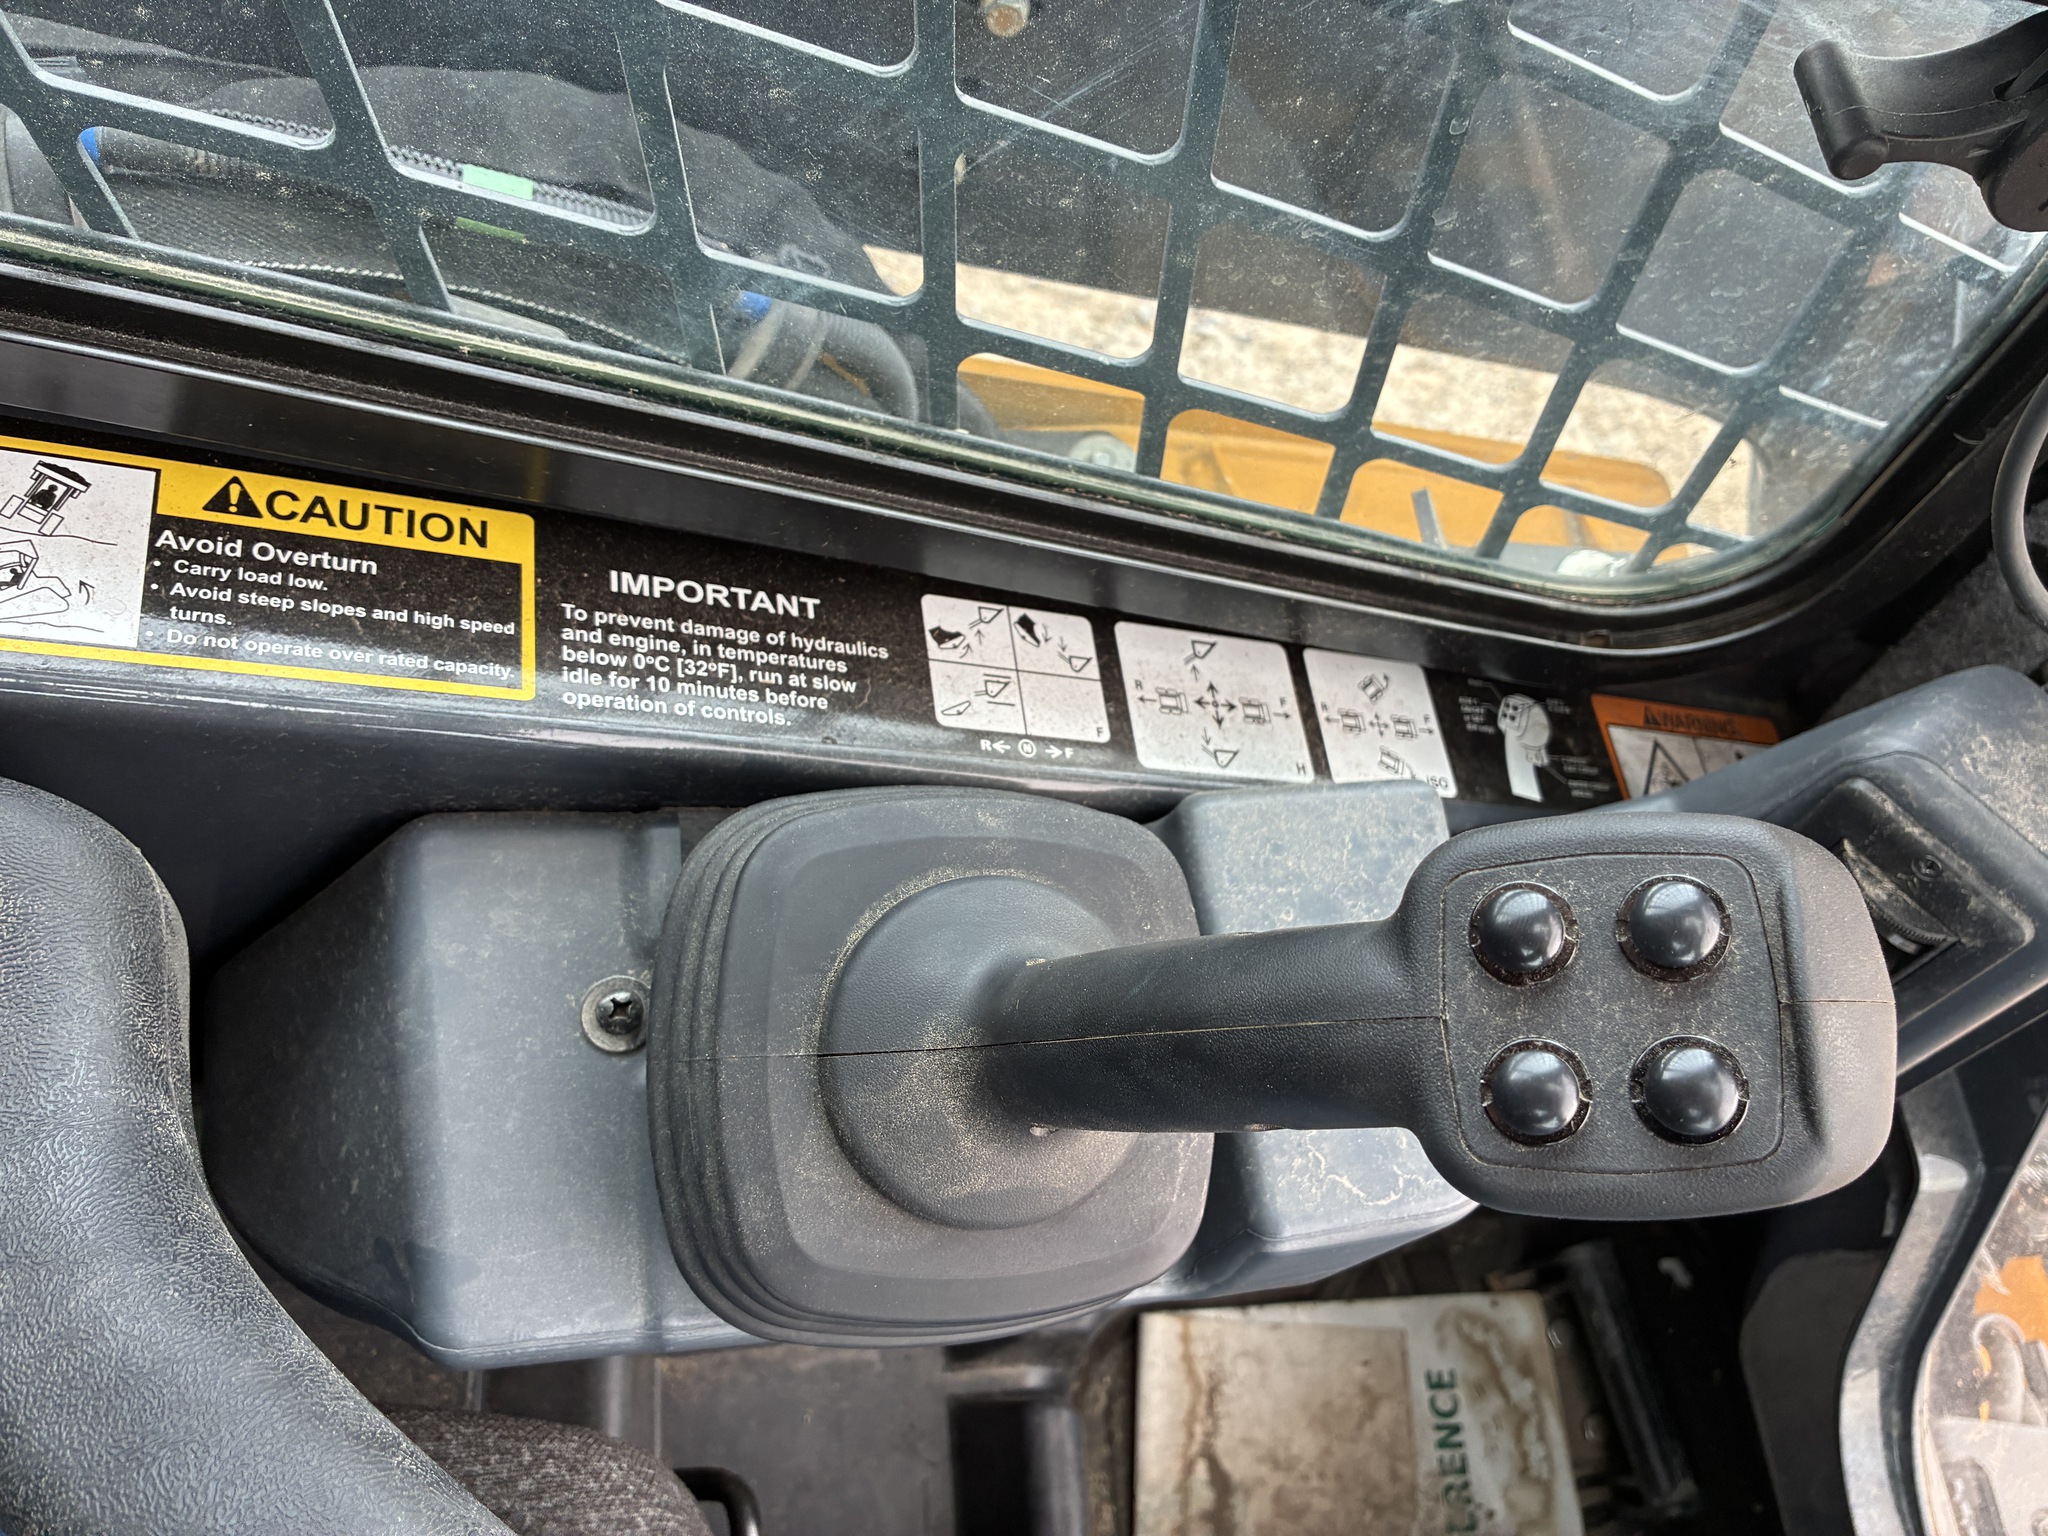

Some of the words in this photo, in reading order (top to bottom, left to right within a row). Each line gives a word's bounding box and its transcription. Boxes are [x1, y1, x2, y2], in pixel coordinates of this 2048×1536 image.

[266, 490, 488, 548] CAUTION
[155, 529, 242, 557] Avoid
[252, 542, 378, 575] Overturn
[173, 559, 232, 582] Carry
[238, 567, 282, 585] load
[288, 574, 328, 591] low.
[169, 606, 233, 626] turns.
[170, 582, 232, 602] Avoid
[238, 592, 295, 612] steep
[300, 599, 367, 617] slopes
[372, 608, 408, 623] and
[413, 611, 455, 630] high
[460, 619, 516, 635] speed
[609, 569, 821, 619] IMPORTANT
[561, 602, 588, 622] To
[594, 609, 675, 632] prevent
[680, 618, 761, 645] damage
[766, 631, 787, 647] of
[791, 634, 889, 659] hydraulics
[561, 626, 602, 645] and
[608, 634, 687, 656] engine,
[692, 639, 712, 657] in
[717, 644, 848, 672] temperatures
[167, 628, 198, 645] Do
[203, 634, 239, 650] not
[245, 638, 324, 658] operate
[329, 649, 374, 664] over
[379, 653, 428, 669] rated
[433, 659, 516, 680] capacity.
[562, 645, 628, 668] below
[749, 670, 783, 686] run
[787, 673, 808, 688] at
[812, 676, 857, 694] slow
[562, 665, 603, 686] idle
[608, 670, 640, 690] for
[647, 675, 671, 694] 10
[677, 680, 760, 702] minutes
[765, 687, 829, 711] before
[1135, 679, 1143, 690] R
[562, 692, 667, 713] operation
[674, 701, 696, 717] of
[701, 703, 792, 727] controls.
[1096, 726, 1104, 738] F
[980, 739, 992, 751] R
[1064, 747, 1074, 759] F
[1295, 762, 1306, 775] H
[1426, 775, 1449, 789] ISO
